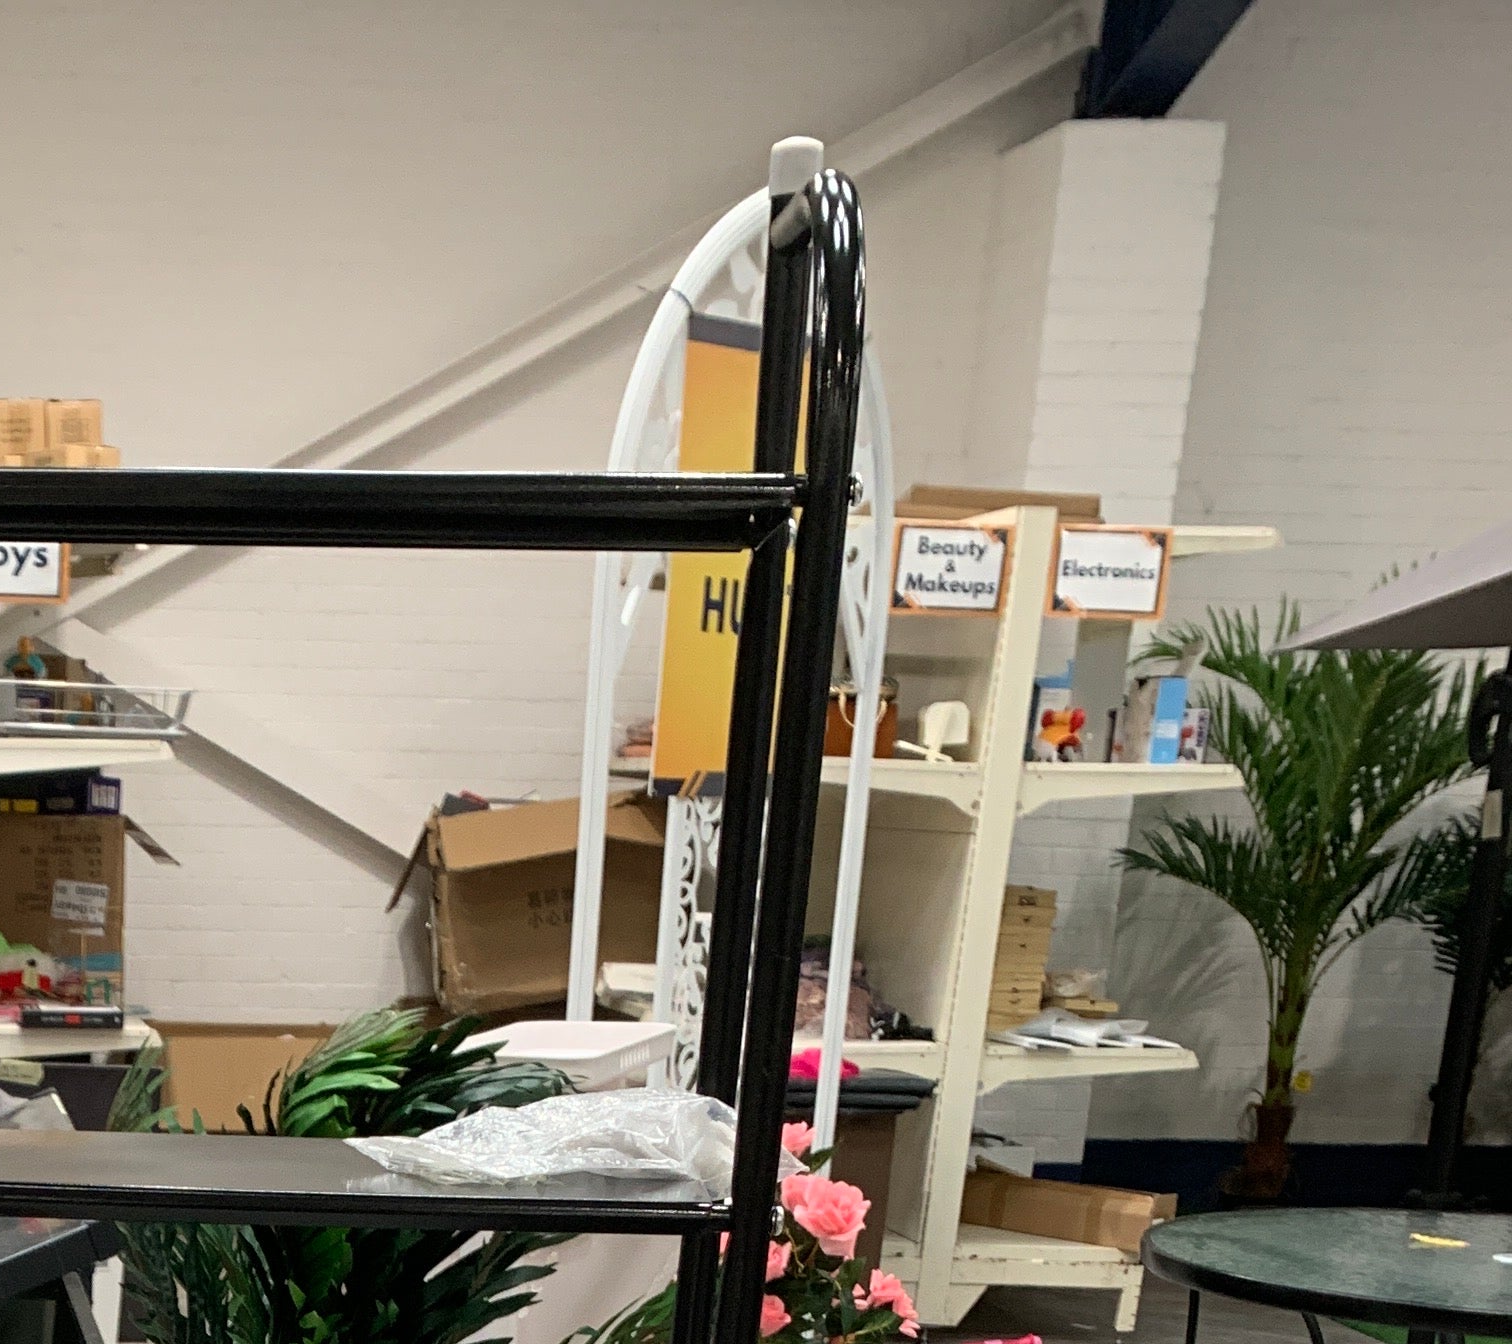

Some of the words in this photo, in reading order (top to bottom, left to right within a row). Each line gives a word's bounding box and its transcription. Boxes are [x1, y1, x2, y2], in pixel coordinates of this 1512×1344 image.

[917, 535, 988, 562] Beauty
[944, 559, 956, 572] &
[1062, 559, 1156, 580] Electronics
[904, 572, 995, 597] Makeups
